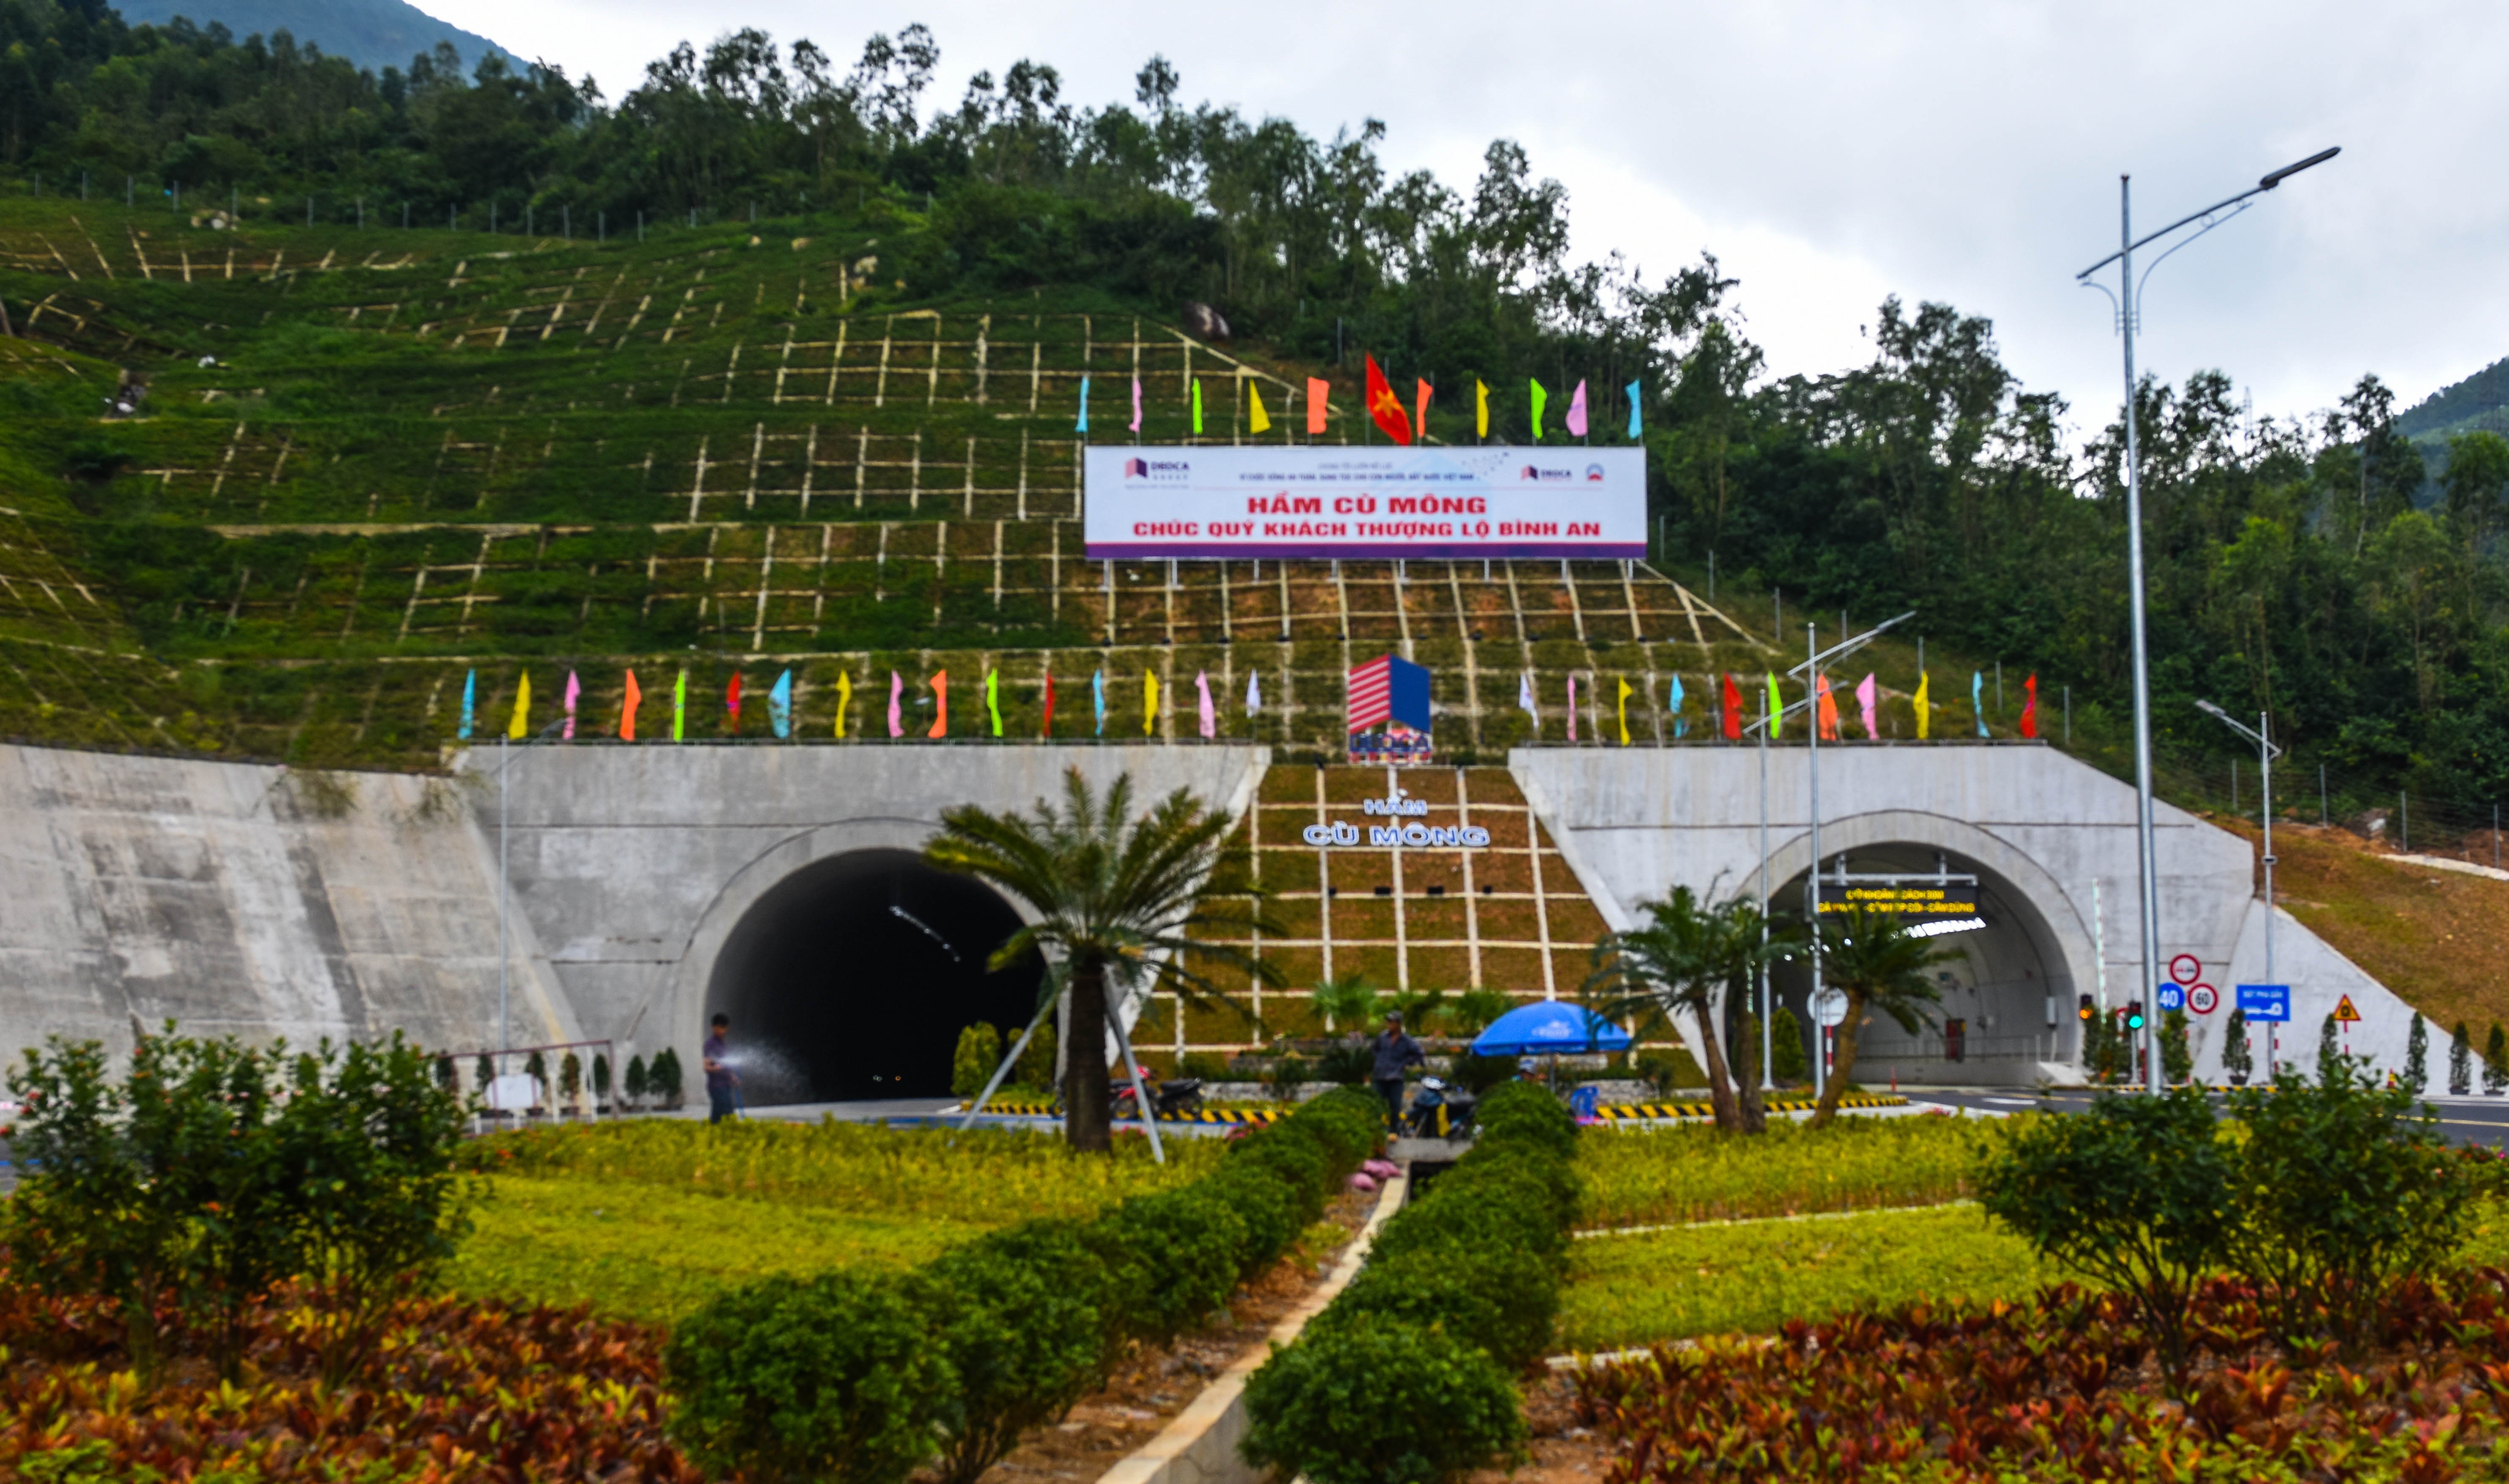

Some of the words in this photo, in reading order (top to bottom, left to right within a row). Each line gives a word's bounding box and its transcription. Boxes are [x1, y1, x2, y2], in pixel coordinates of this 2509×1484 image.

[1389, 493, 1486, 514] MÔNG
[1133, 520, 1198, 536] CHÚC
[1208, 520, 1254, 537] QUÝ
[1264, 520, 1347, 536] KHÁCH
[1355, 521, 1453, 540] THƯỢNG
[1461, 521, 1490, 540] LỘ
[1498, 519, 1558, 536] BÌNH
[1566, 522, 1601, 536] AN
[1303, 820, 1359, 846] CÙ
[1369, 821, 1490, 847] MÔNG
[2159, 990, 2179, 1007] 40
[2195, 992, 2210, 1005] 60
